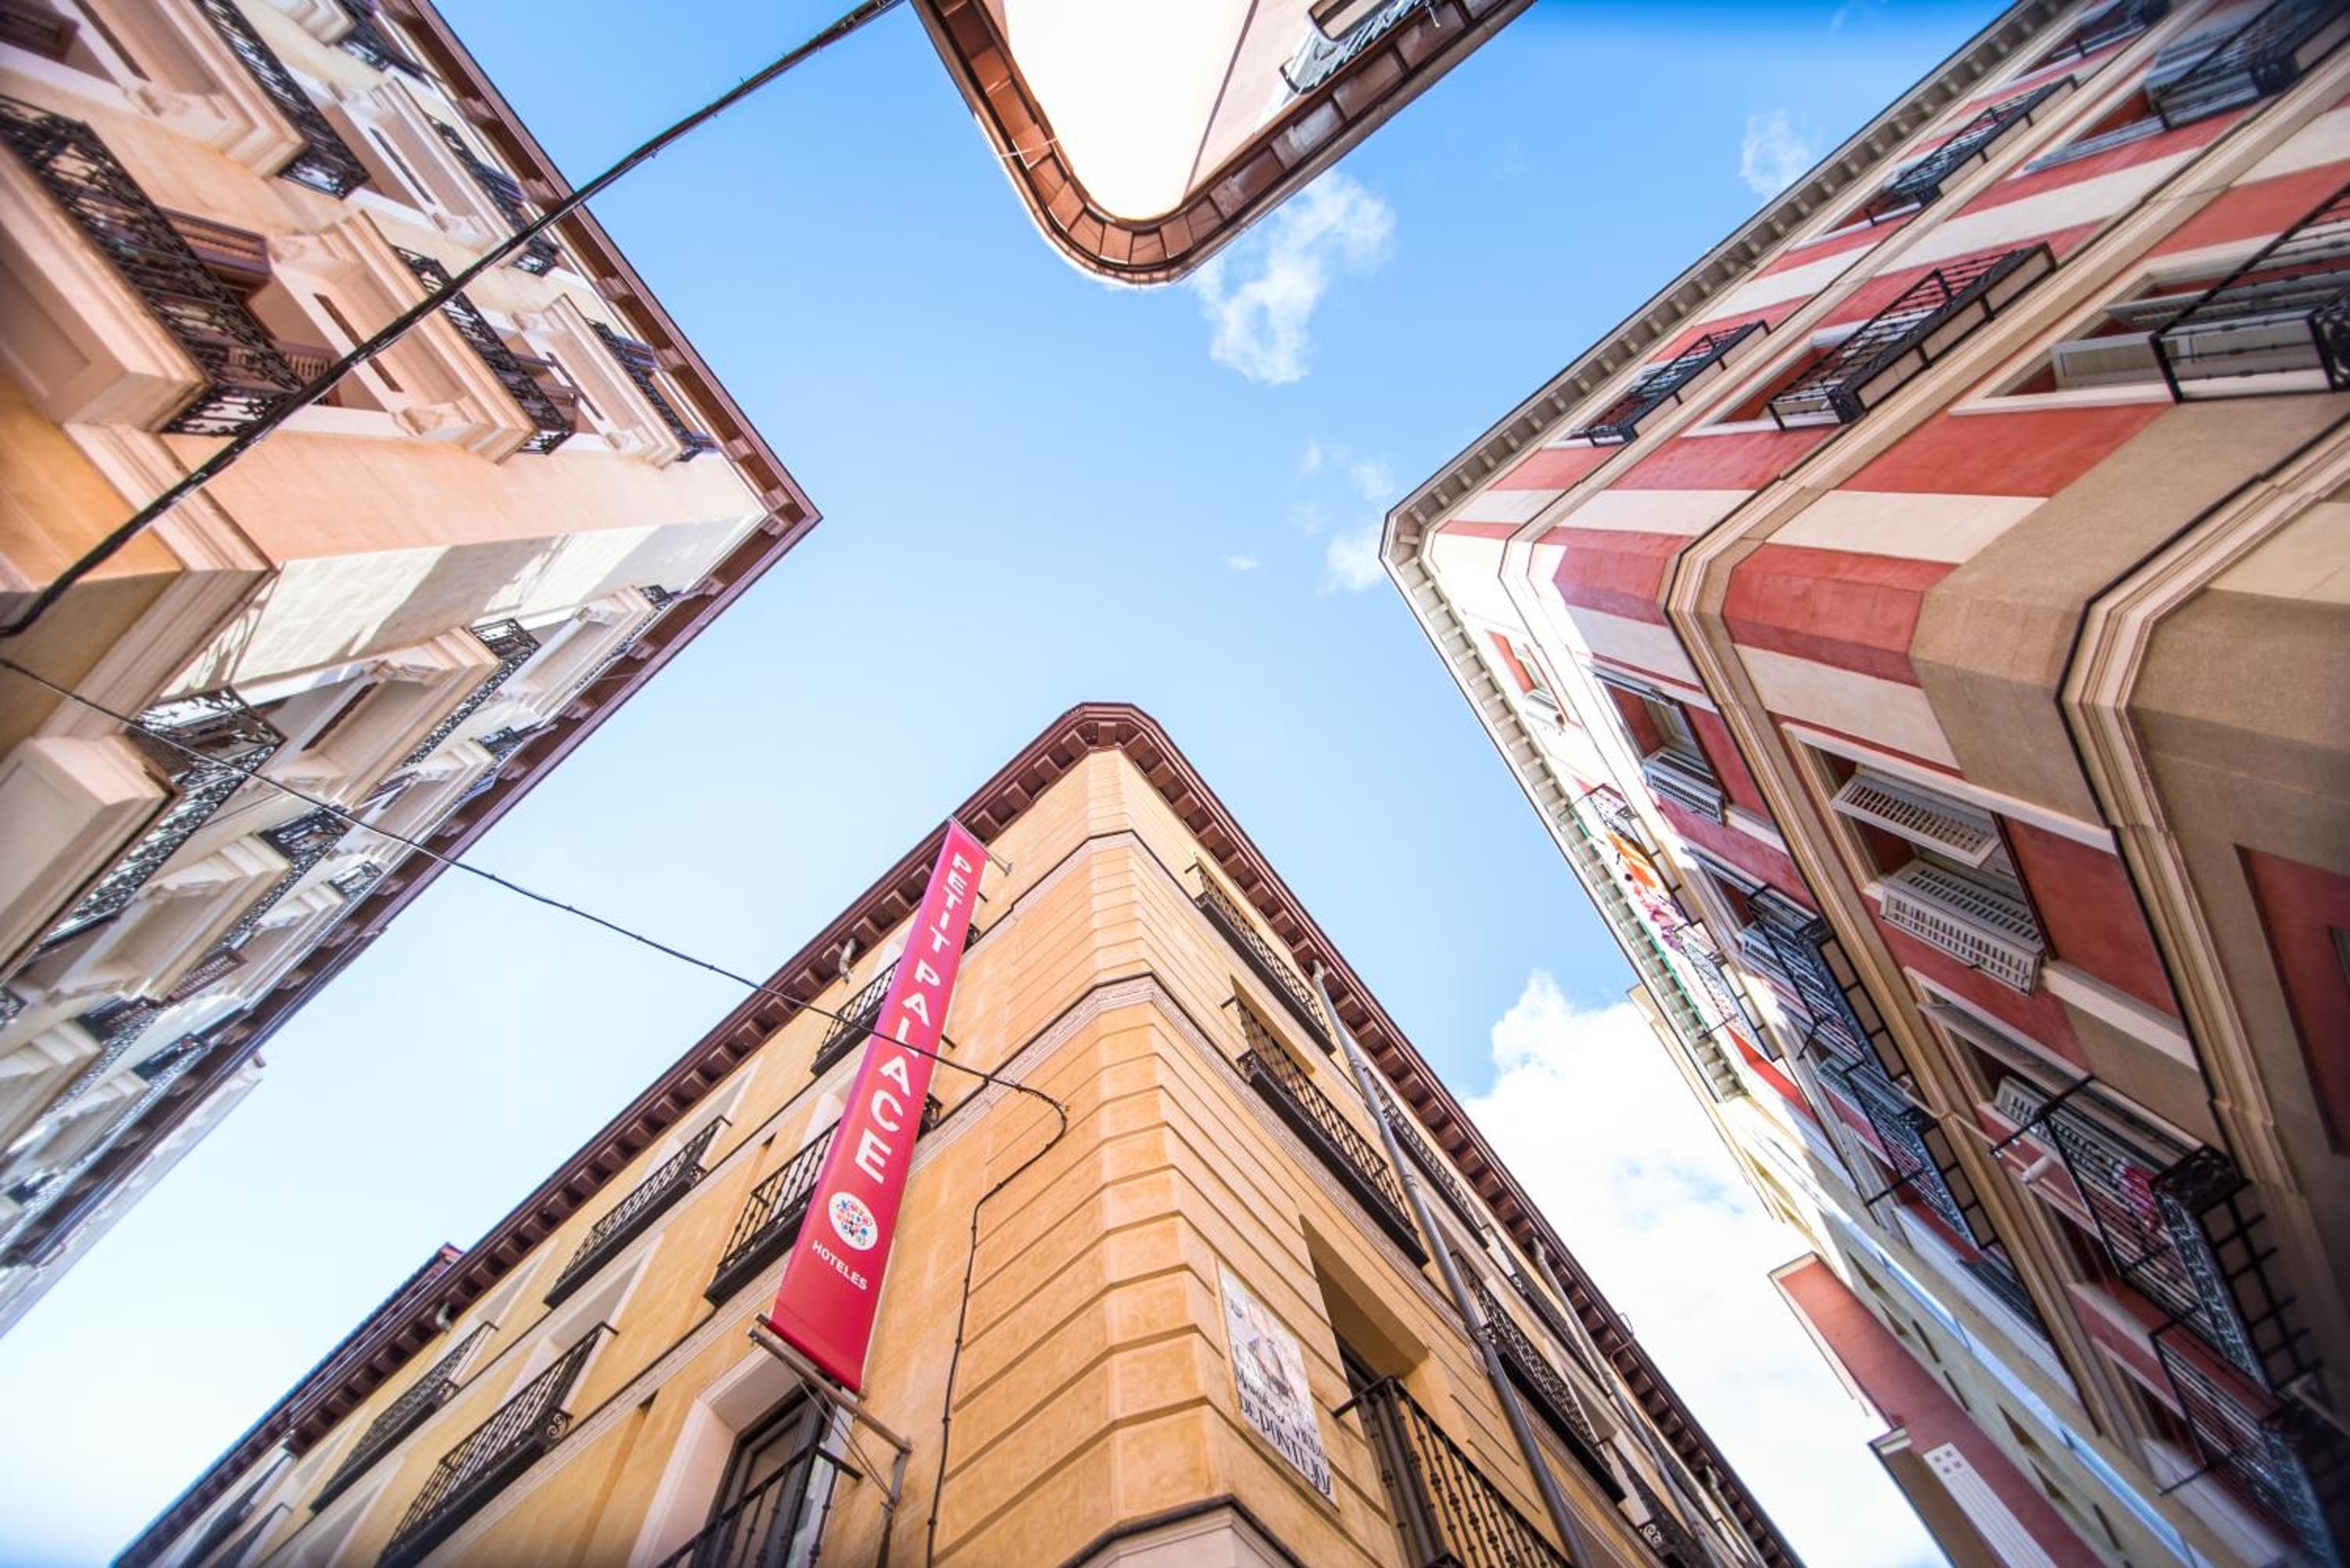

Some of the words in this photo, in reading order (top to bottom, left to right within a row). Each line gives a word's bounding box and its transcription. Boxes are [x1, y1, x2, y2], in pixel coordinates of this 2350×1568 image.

[930, 852, 972, 952] PETIT
[855, 959, 941, 1184] PALACE
[812, 1240, 868, 1291] HOTELES
